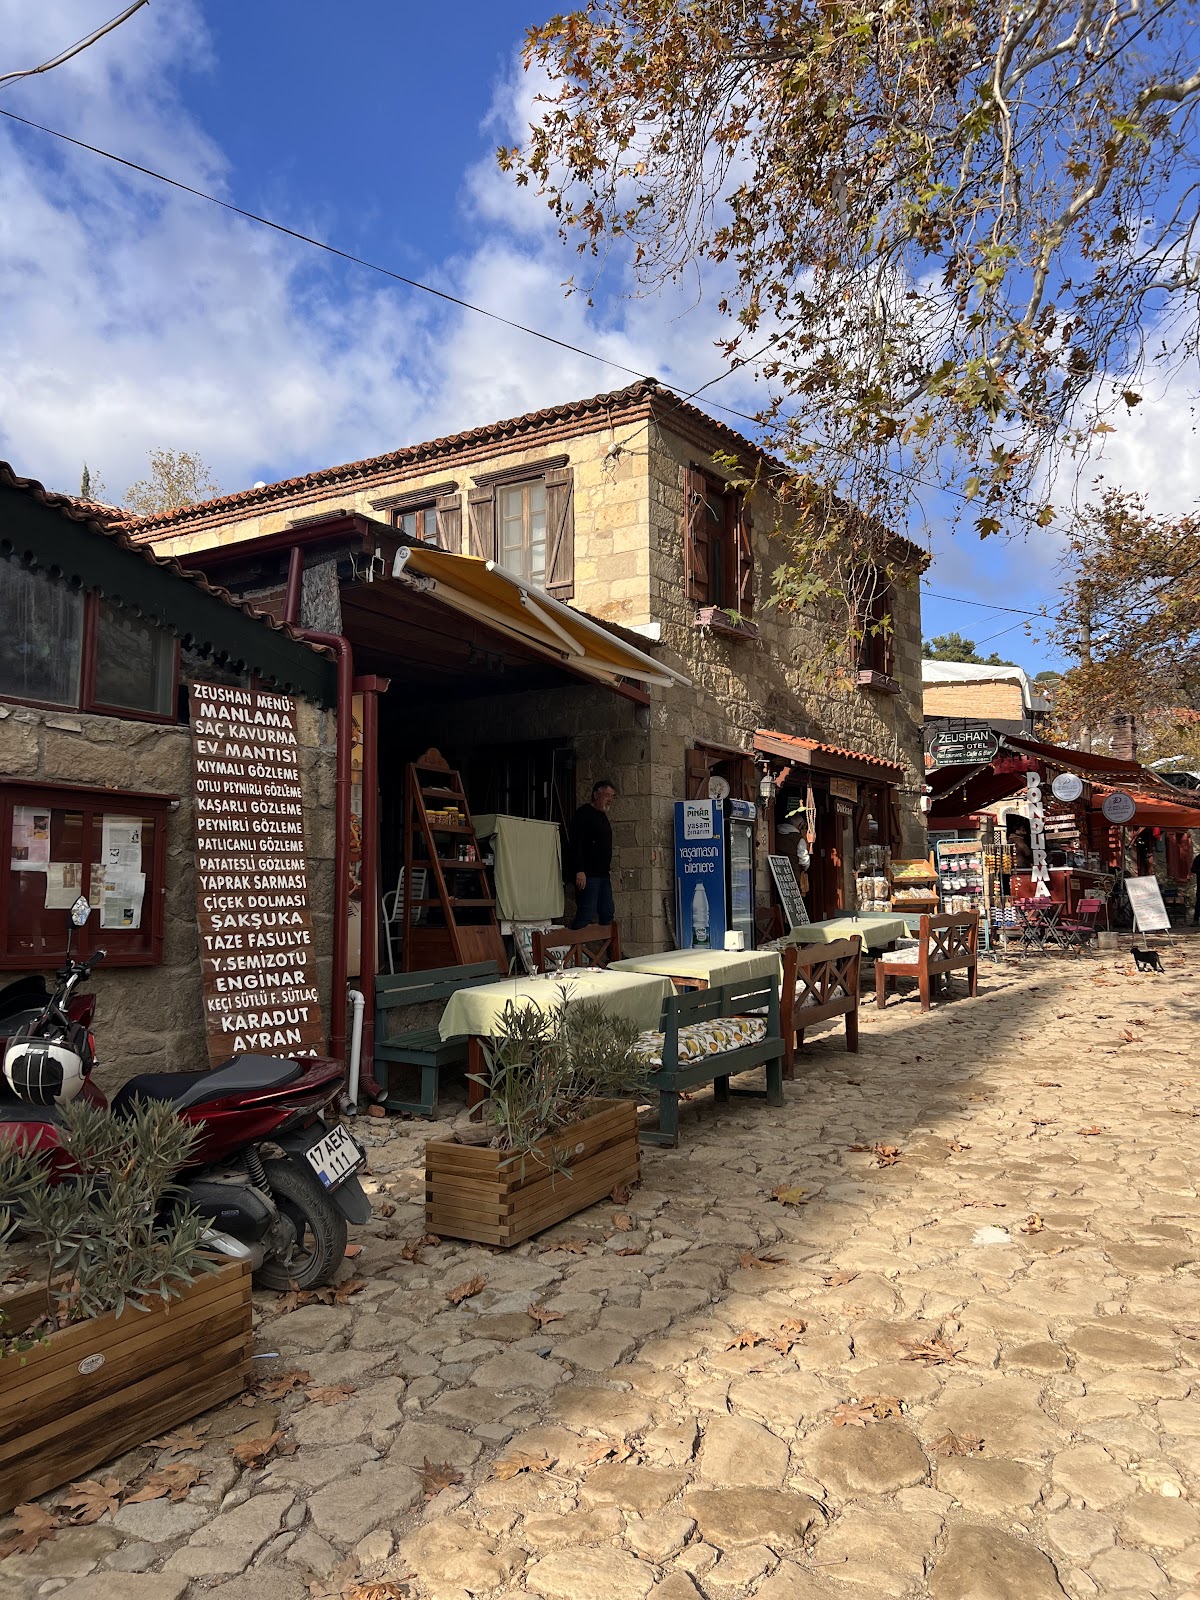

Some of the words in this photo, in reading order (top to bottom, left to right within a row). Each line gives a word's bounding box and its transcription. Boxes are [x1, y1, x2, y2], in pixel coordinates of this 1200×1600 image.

[193, 683, 252, 706] ZEUSHAN
[256, 695, 295, 712] MENÜ:
[200, 702, 293, 729] MANLAMA
[195, 720, 224, 739] SAÇ
[228, 724, 298, 745] KAVURMA
[938, 731, 988, 743] ZEUSHAN
[197, 739, 219, 754] EV
[225, 743, 297, 763] MANTISI
[197, 760, 245, 776] KIYMALI
[248, 763, 299, 781] GÖZLEME
[197, 780, 221, 792] OTLU
[264, 782, 302, 798] GÖZLEME
[198, 799, 247, 813] KAŞARLI
[250, 799, 302, 815] GÖZLEME
[687, 809, 709, 817] PINAR
[198, 816, 249, 832] PEYNİRLİ
[252, 818, 302, 834] GÖZLEME
[1026, 772, 1052, 898] DONDURMA
[197, 838, 257, 851] PATLICANLI
[259, 837, 304, 852] GÖZLEME
[199, 854, 256, 871] PATATESLİ
[258, 855, 306, 871] GÖZLEME
[199, 875, 251, 890] YAPRAK
[253, 874, 307, 889] SARMASI
[203, 893, 244, 912] ÇİÇEK
[247, 895, 306, 908] DOLMASI
[210, 911, 303, 931] ŞAKŞUKA
[204, 934, 243, 950] TAZE
[247, 930, 311, 948] FASULYE
[210, 950, 307, 972] Y.SEMİZOTU
[216, 970, 306, 992] ENGİNAR
[207, 994, 232, 1013] KEÇİ
[234, 990, 268, 1009] SÜTLÜ
[270, 991, 280, 1004] F.
[281, 987, 318, 1003] SÜTLAÇ
[221, 1007, 309, 1033] KARADUT
[233, 1028, 302, 1052] AYRAN
[309, 1145, 324, 1167] 17
[324, 1126, 349, 1156] AEK
[329, 1151, 351, 1176] 111
